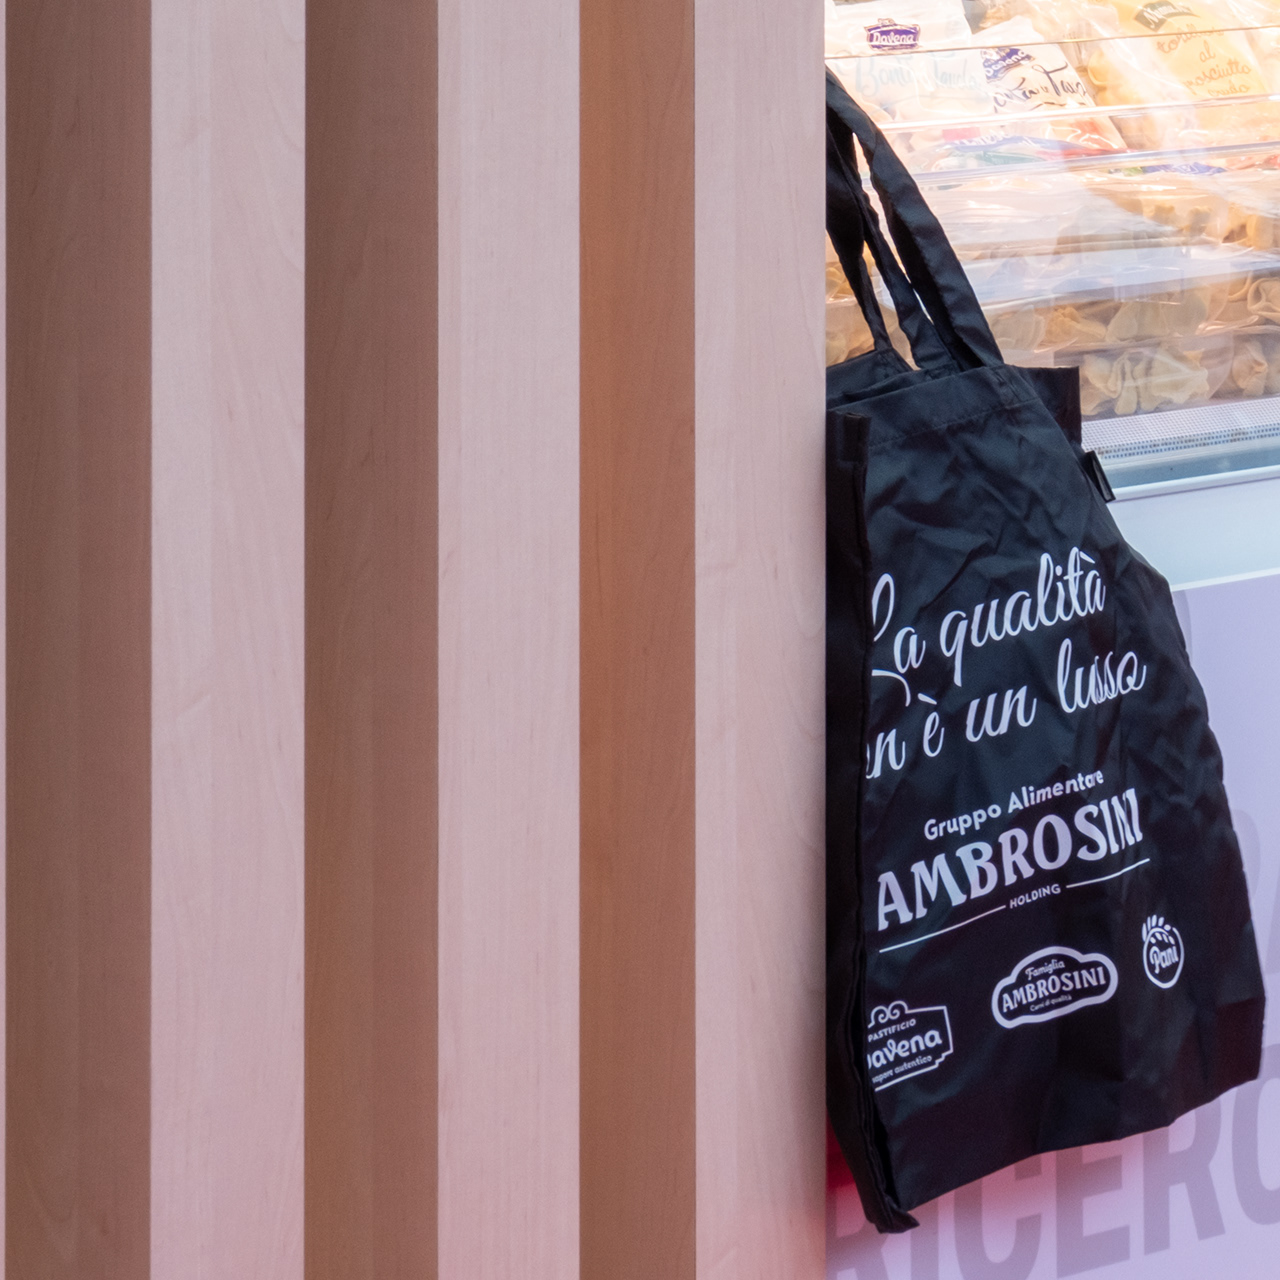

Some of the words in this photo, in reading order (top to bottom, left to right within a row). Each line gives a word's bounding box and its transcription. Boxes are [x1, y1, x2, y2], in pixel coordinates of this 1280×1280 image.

[872, 31, 915, 46] Davena
[938, 545, 1107, 688] qualità
[917, 693, 945, 758] è
[965, 684, 1038, 743] un
[1056, 637, 1148, 714] lusso
[923, 804, 1002, 841] Gruppo
[876, 787, 1144, 932] AMBROSINI
[1009, 883, 1062, 910] HOLDING
[1025, 958, 1066, 981] Famiglia
[1001, 966, 1107, 1013] AMBROSINI
[867, 1018, 917, 1043] PASTIFICIO
